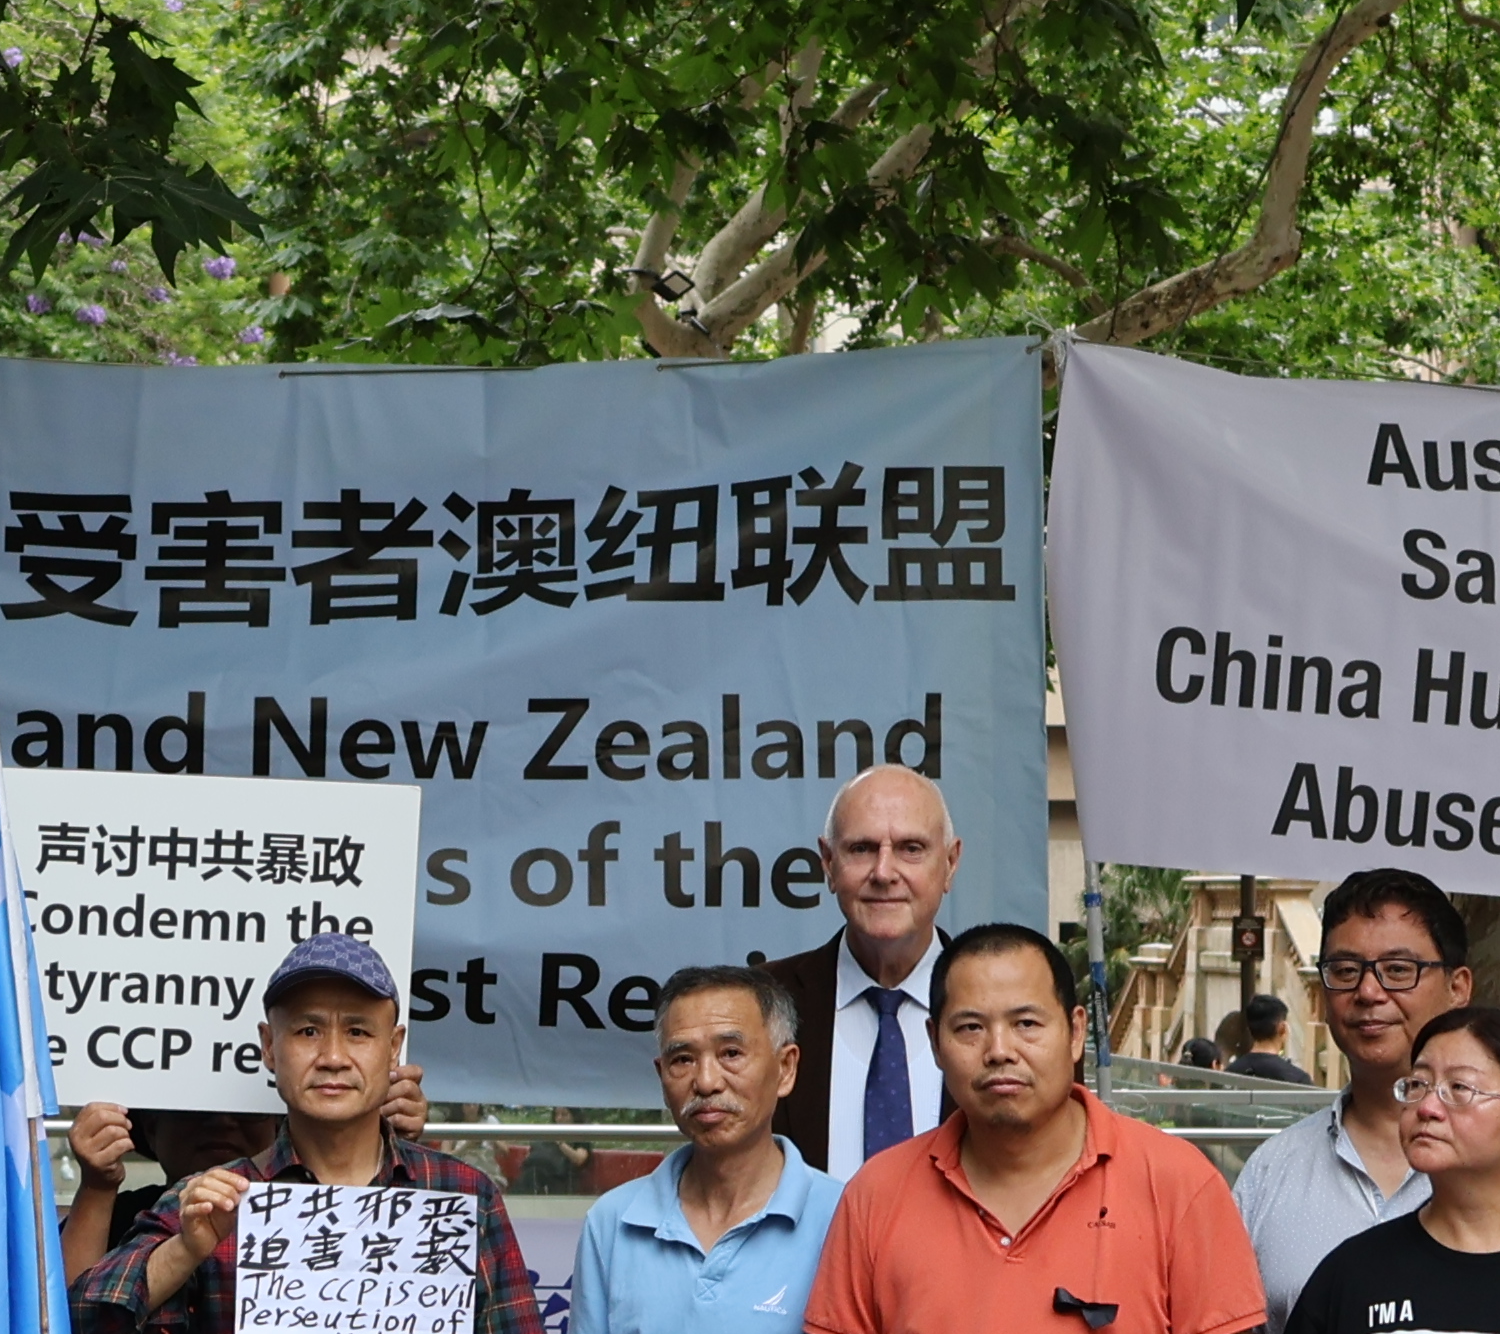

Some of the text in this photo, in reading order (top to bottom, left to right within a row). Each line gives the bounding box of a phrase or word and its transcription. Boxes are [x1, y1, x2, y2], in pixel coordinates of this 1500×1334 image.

[1154, 625, 1382, 719] China
[10, 691, 206, 775] and
[252, 695, 488, 780] New
[523, 693, 943, 781] Zealand
[35, 821, 366, 889] 声讨中共暴政
[509, 820, 621, 907] of
[653, 820, 826, 909] the
[286, 900, 375, 945] the
[45, 959, 256, 1021] tyranny
[86, 1025, 194, 1071] CCP
[247, 1183, 477, 1236] 中共邪恶
[239, 1296, 418, 1334] Perseution
[242, 1269, 307, 1301] The
[318, 1277, 379, 1306] CCP
[418, 1278, 476, 1308] evil
[1368, 1299, 1414, 1327] I'M A
